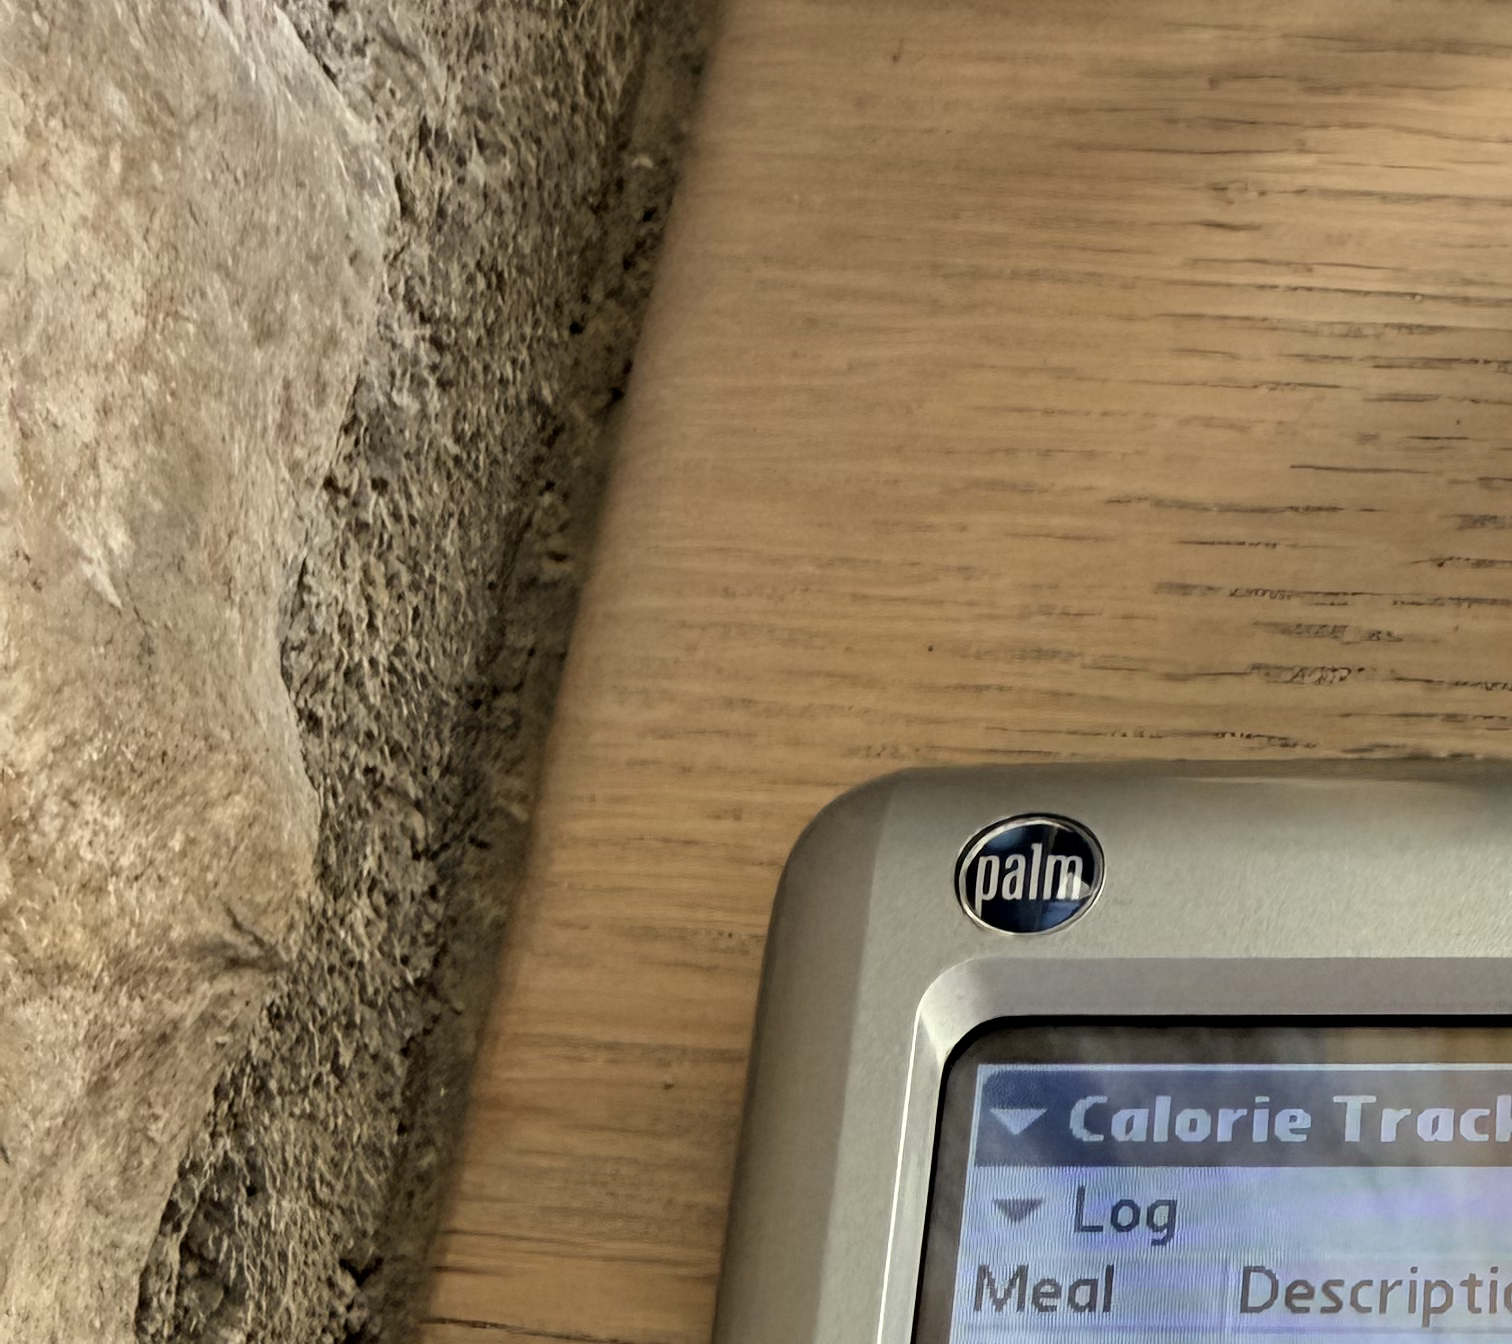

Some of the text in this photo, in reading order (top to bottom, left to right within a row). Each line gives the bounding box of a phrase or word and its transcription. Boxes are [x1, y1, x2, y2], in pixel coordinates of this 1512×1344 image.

[974, 843, 1085, 914] palm
[1069, 1095, 1312, 1143] Calorie
[1073, 1187, 1178, 1246] Log
[972, 1264, 1115, 1313] Meal
